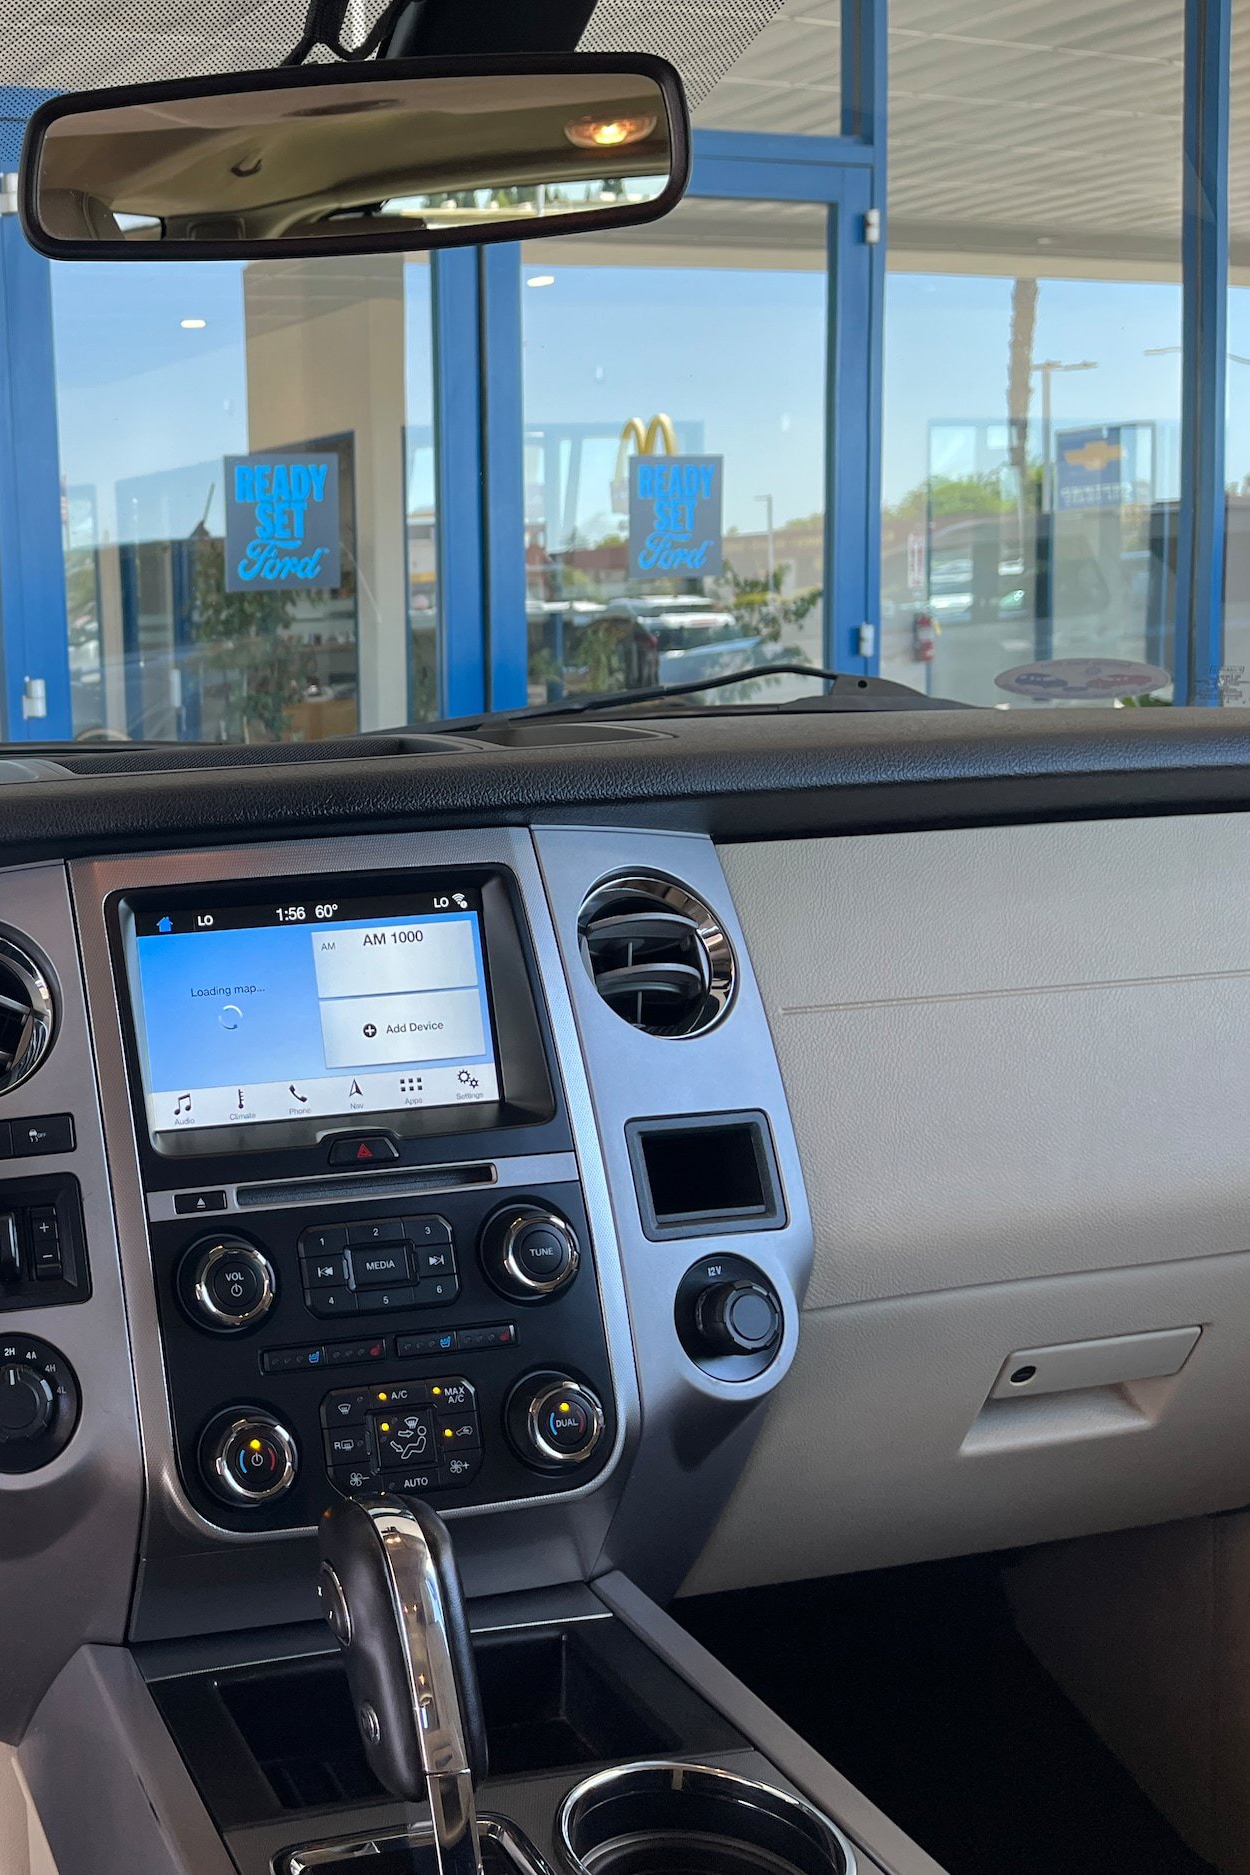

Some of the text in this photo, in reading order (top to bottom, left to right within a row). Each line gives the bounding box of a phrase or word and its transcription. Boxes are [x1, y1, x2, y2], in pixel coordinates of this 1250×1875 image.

[235, 464, 327, 502] READY
[638, 464, 715, 499] READY
[255, 500, 307, 539] SET
[654, 498, 697, 532] SET
[638, 532, 710, 570] Ford
[238, 539, 323, 580] Ford
[433, 897, 449, 908] LO
[197, 903, 338, 926] LO 1:56 60°
[362, 930, 424, 946] AM 1000
[321, 942, 336, 952] AM
[190, 983, 266, 998] Loading map...
[386, 1020, 444, 1034] Add Device
[456, 1091, 483, 1101] Settings
[350, 1102, 364, 1110] Nav
[404, 1097, 423, 1106] Apps
[229, 1111, 256, 1121] Climate
[288, 1107, 311, 1116] Phone
[174, 1117, 195, 1126] Audio
[372, 1227, 379, 1236] 2
[424, 1226, 431, 1235] 3
[319, 1237, 325, 1246] 1
[529, 1246, 554, 1257] TUNE
[366, 1259, 396, 1271] MEDIA
[707, 1265, 722, 1277] 12V
[225, 1271, 244, 1282] VOL
[436, 1285, 443, 1294] 6
[328, 1296, 335, 1305] 4
[383, 1296, 389, 1304] 5
[4, 1347, 16, 1357] 2H
[25, 1351, 37, 1360] 4A
[44, 1363, 56, 1373] 4H
[56, 1385, 67, 1394] 4L
[444, 1386, 466, 1396] MAX
[391, 1390, 408, 1400] A/C
[448, 1394, 465, 1404] A/C
[555, 1416, 580, 1428] DUAL
[403, 1476, 429, 1488] AUTO
